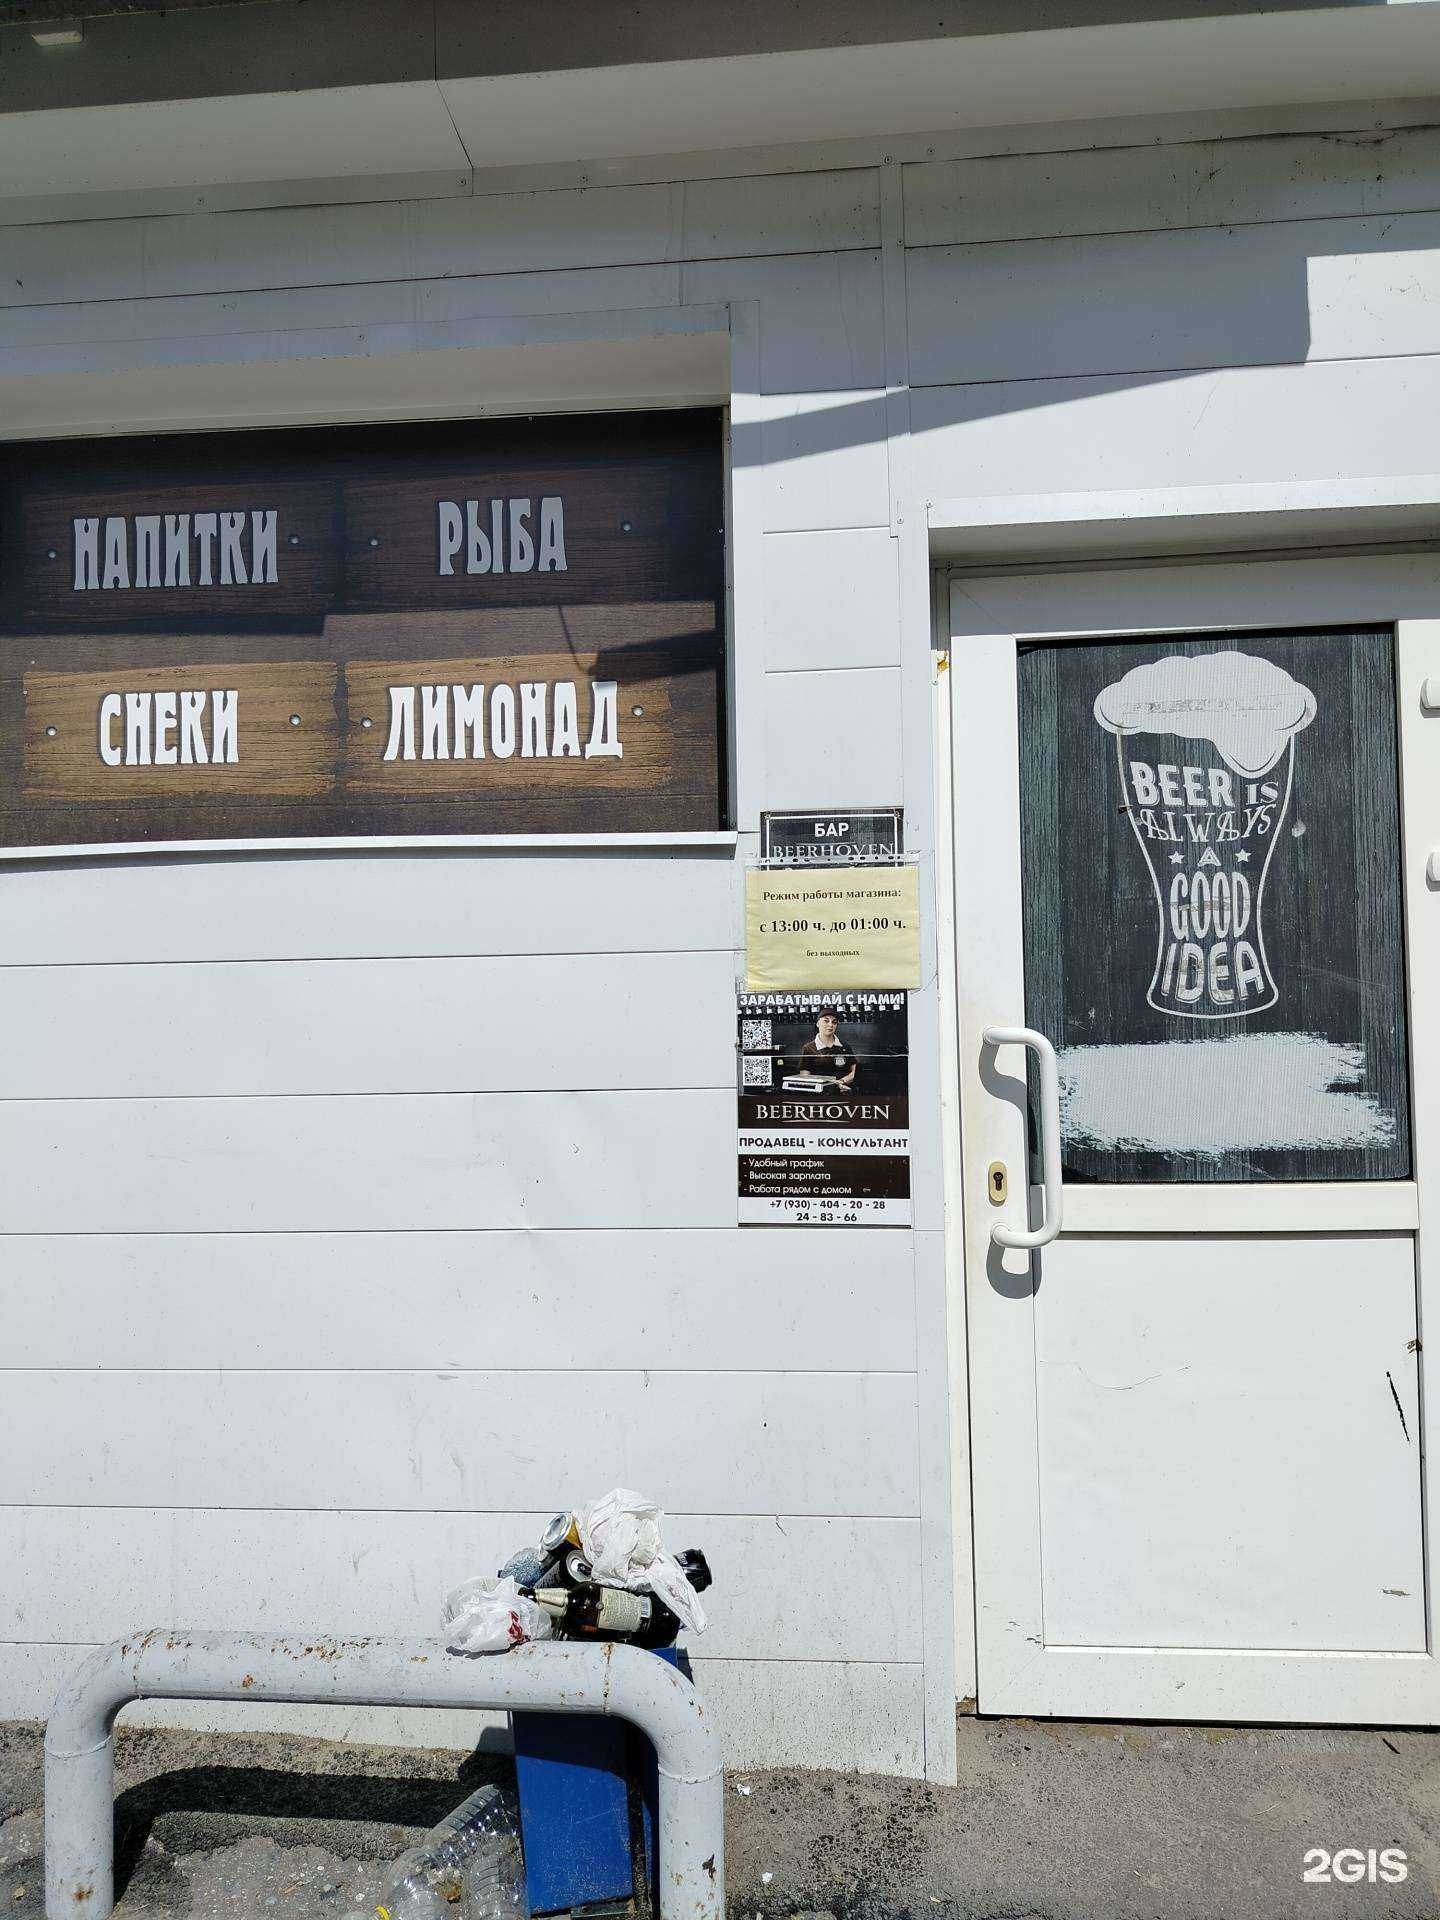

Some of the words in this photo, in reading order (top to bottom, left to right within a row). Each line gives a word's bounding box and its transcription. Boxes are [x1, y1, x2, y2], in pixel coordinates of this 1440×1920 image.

[439, 496, 568, 576] РЫБА
[73, 510, 279, 590] НАПИТКИ
[99, 690, 239, 766] СНЕКИ
[384, 681, 623, 761] ЛИМОНАД
[1130, 761, 1235, 807] BEER
[1245, 781, 1279, 806] IS
[814, 822, 850, 838] БАР
[1140, 804, 1277, 842] ALWAYS
[772, 843, 895, 858] BEERHOVEN
[1198, 846, 1221, 867] A
[763, 891, 800, 901] Режим
[803, 890, 843, 902] работы
[846, 888, 902, 898] магазина:
[1170, 871, 1250, 941] GOOD
[771, 920, 809, 932] 13:00
[813, 922, 826, 931] ч.
[830, 921, 847, 933] до
[851, 917, 889, 930] 01:00
[893, 920, 906, 929] ч.
[1161, 941, 1265, 1005] IDEA
[740, 991, 842, 1006] ЗАРАБАТЫВАЙ
[845, 994, 855, 1005] С
[858, 992, 905, 1005] НАМИ!
[756, 1104, 890, 1121] BEERHOVEN
[739, 1137, 805, 1149] ПРОДАВЕЦ
[817, 1138, 908, 1149] КОНСУЛЬТАНТ
[749, 1158, 788, 1168] Удобный
[790, 1160, 825, 1169] график
[750, 1171, 787, 1180] Высокая
[789, 1173, 831, 1181] зарплата
[750, 1185, 781, 1193] Работа
[783, 1187, 811, 1195] рядом
[821, 1187, 852, 1195] домом
[770, 1200, 782, 1208] +7
[784, 1200, 811, 1210] (930)
[820, 1200, 840, 1209] 404
[850, 1200, 863, 1209] 20
[873, 1201, 886, 1210] 28
[796, 1213, 810, 1221] 24
[820, 1213, 834, 1222] 83
[844, 1213, 858, 1222] 66
